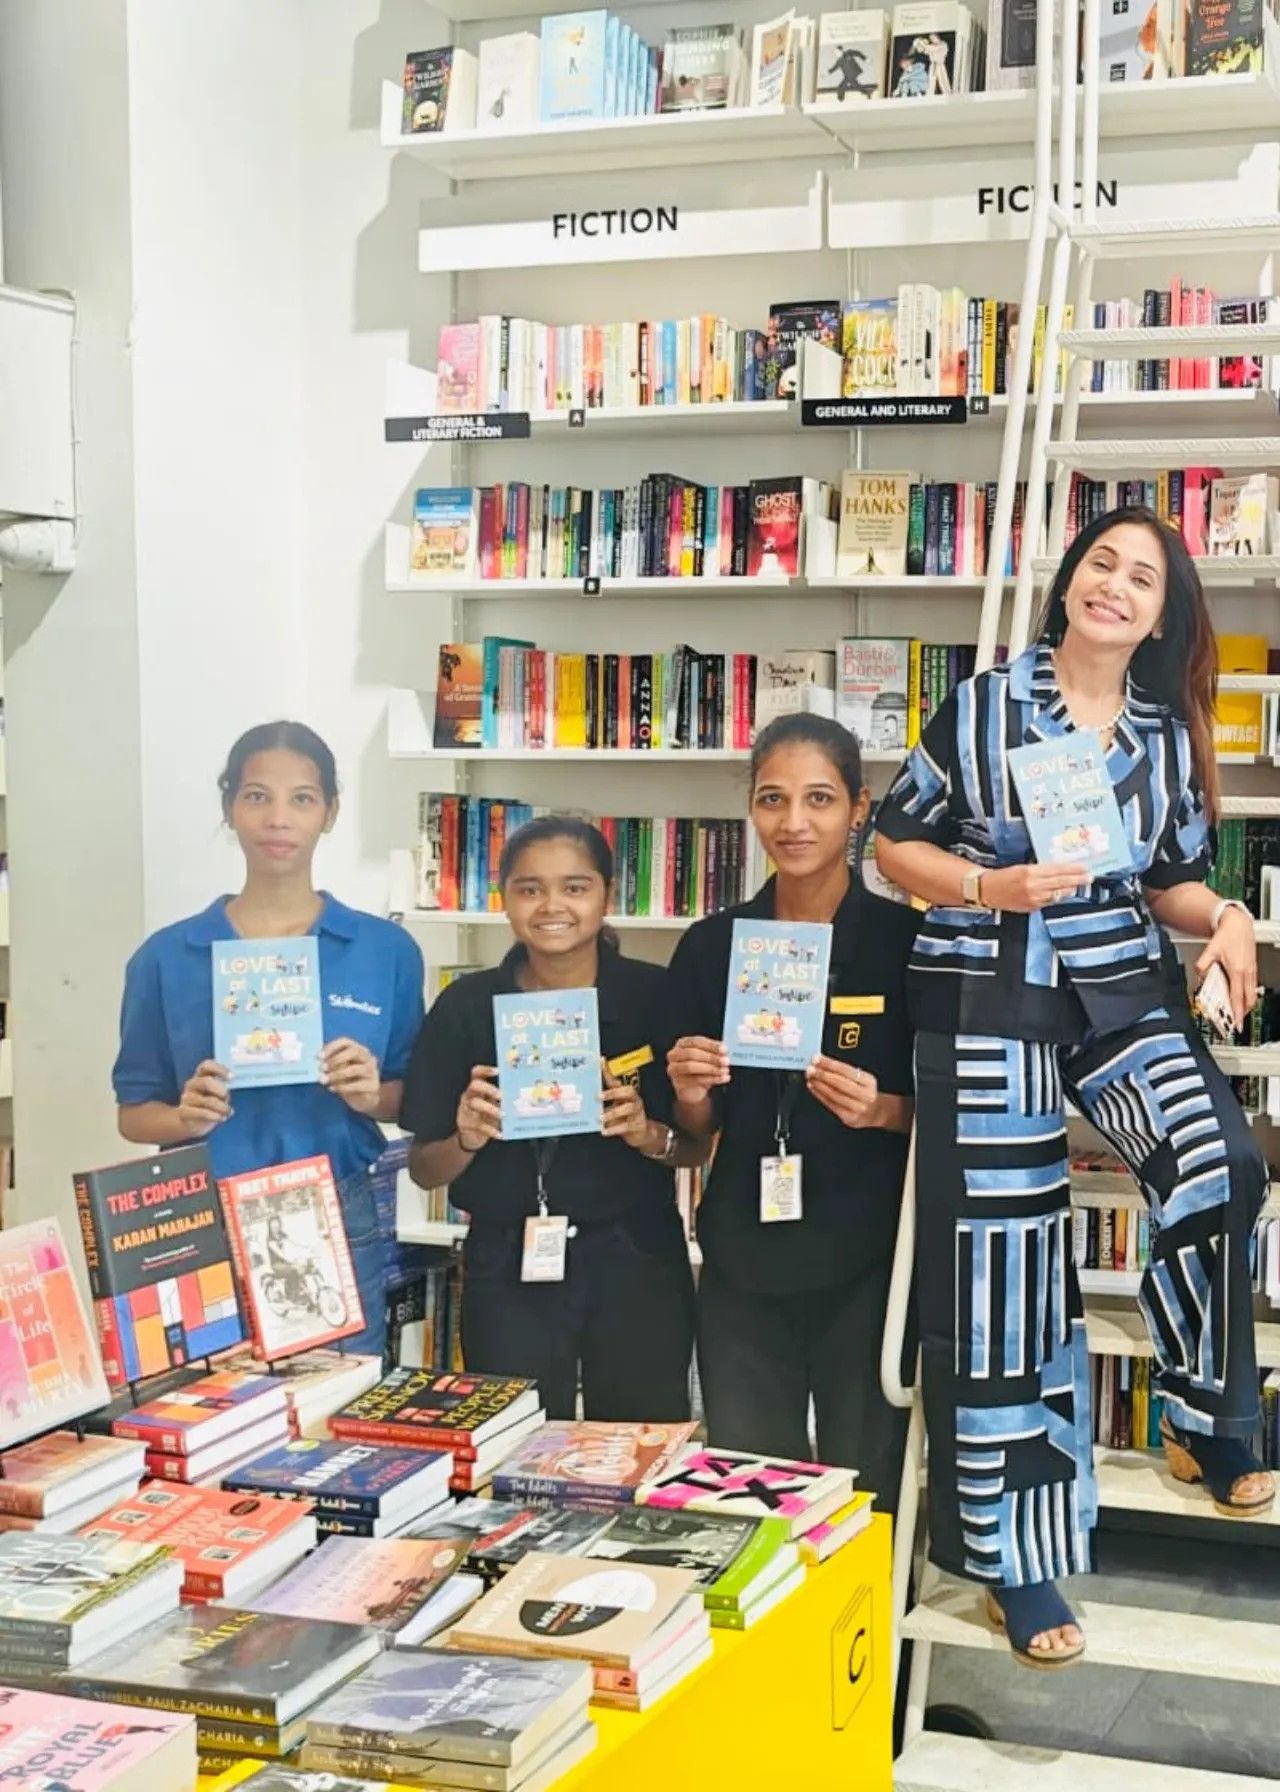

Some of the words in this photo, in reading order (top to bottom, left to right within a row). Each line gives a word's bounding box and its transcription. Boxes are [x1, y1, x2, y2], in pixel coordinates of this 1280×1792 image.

[978, 180, 1118, 215] FICIN
[552, 206, 679, 239] FICTION
[815, 405, 869, 418] GENERAL
[870, 405, 896, 417] AND
[899, 404, 952, 417] LITERARY
[975, 402, 984, 411] H
[412, 427, 459, 440] LITERARY
[460, 425, 502, 439] FICTION
[427, 416, 476, 429] GENERAL
[859, 479, 897, 496] TOM
[754, 492, 797, 508] GHOST
[844, 497, 906, 517] HANKS
[738, 936, 791, 954] LOVE
[773, 963, 821, 980] LAST
[261, 976, 313, 994] LAST
[502, 1009, 556, 1030] LOVE
[541, 1028, 590, 1048] LAST
[76, 1183, 89, 1209] THE
[106, 1190, 140, 1215] THE
[141, 1172, 208, 1207] COMPLEX
[80, 1211, 98, 1268] COMPLEX
[112, 1228, 156, 1252] KARAN
[158, 1209, 215, 1240] MAHAJAN
[357, 1368, 436, 1422] SHENOY
[441, 1380, 502, 1424] PEOPLE
[454, 1409, 483, 1430] WE
[480, 1378, 528, 1415] LOVE
[292, 1444, 380, 1488] HAMNET
[848, 1627, 867, 1684] C
[179, 1700, 244, 1718] ZACHARIA
[44, 1736, 124, 1783] BLUE
